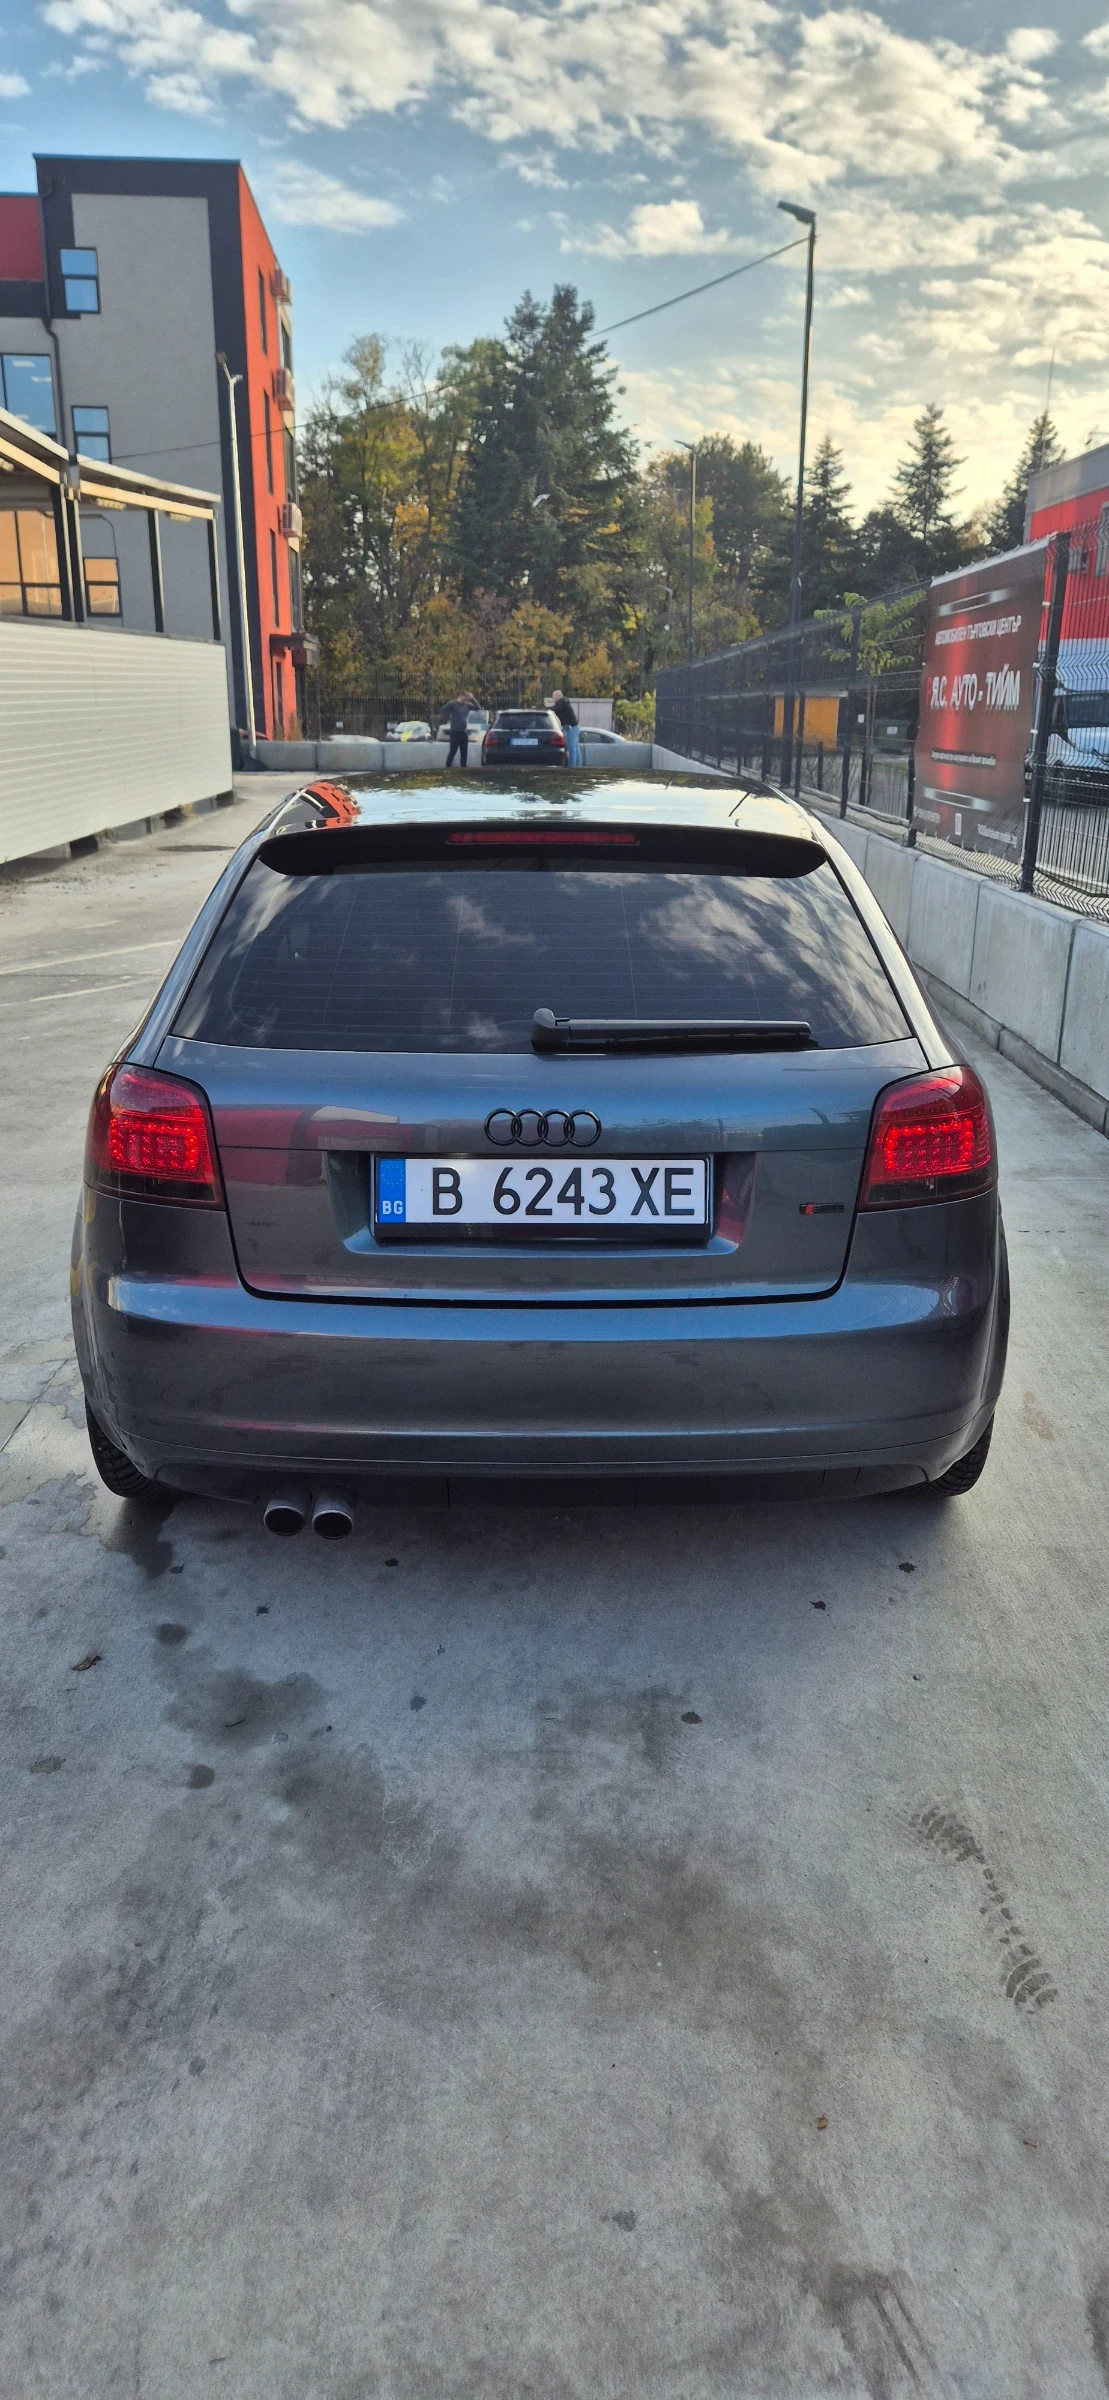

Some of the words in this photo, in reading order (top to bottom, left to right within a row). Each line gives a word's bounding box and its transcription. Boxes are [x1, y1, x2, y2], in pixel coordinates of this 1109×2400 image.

[996, 615, 1022, 637] ЦЕНТЪР
[950, 672, 978, 710] АУТО
[985, 663, 1020, 710] ТИЙМ
[382, 1200, 404, 1215] BG
[432, 1167, 463, 1215] B
[493, 1167, 616, 1215] 6243
[630, 1167, 695, 1215] XE
